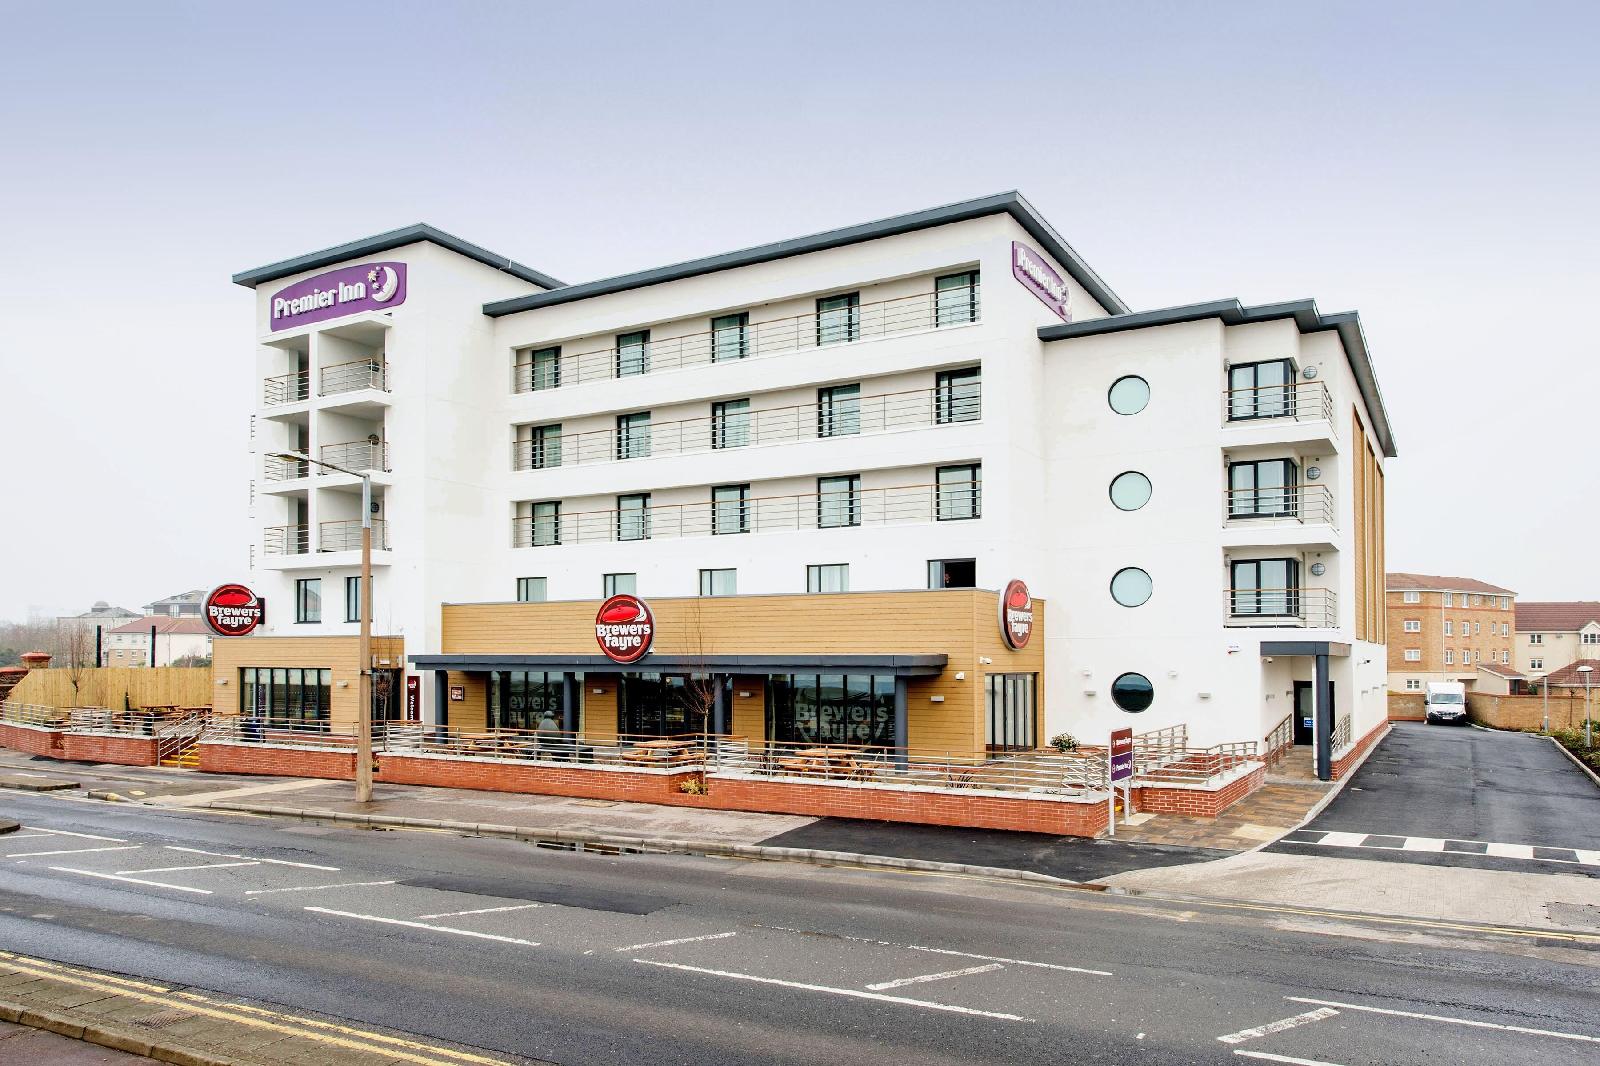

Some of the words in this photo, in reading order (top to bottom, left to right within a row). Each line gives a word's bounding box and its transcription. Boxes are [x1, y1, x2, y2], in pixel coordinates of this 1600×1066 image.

[1018, 248, 1050, 288] Premier
[274, 289, 338, 319] Premier
[339, 282, 366, 303] Inn
[209, 606, 260, 616] Brewers
[596, 624, 651, 636] Brewers
